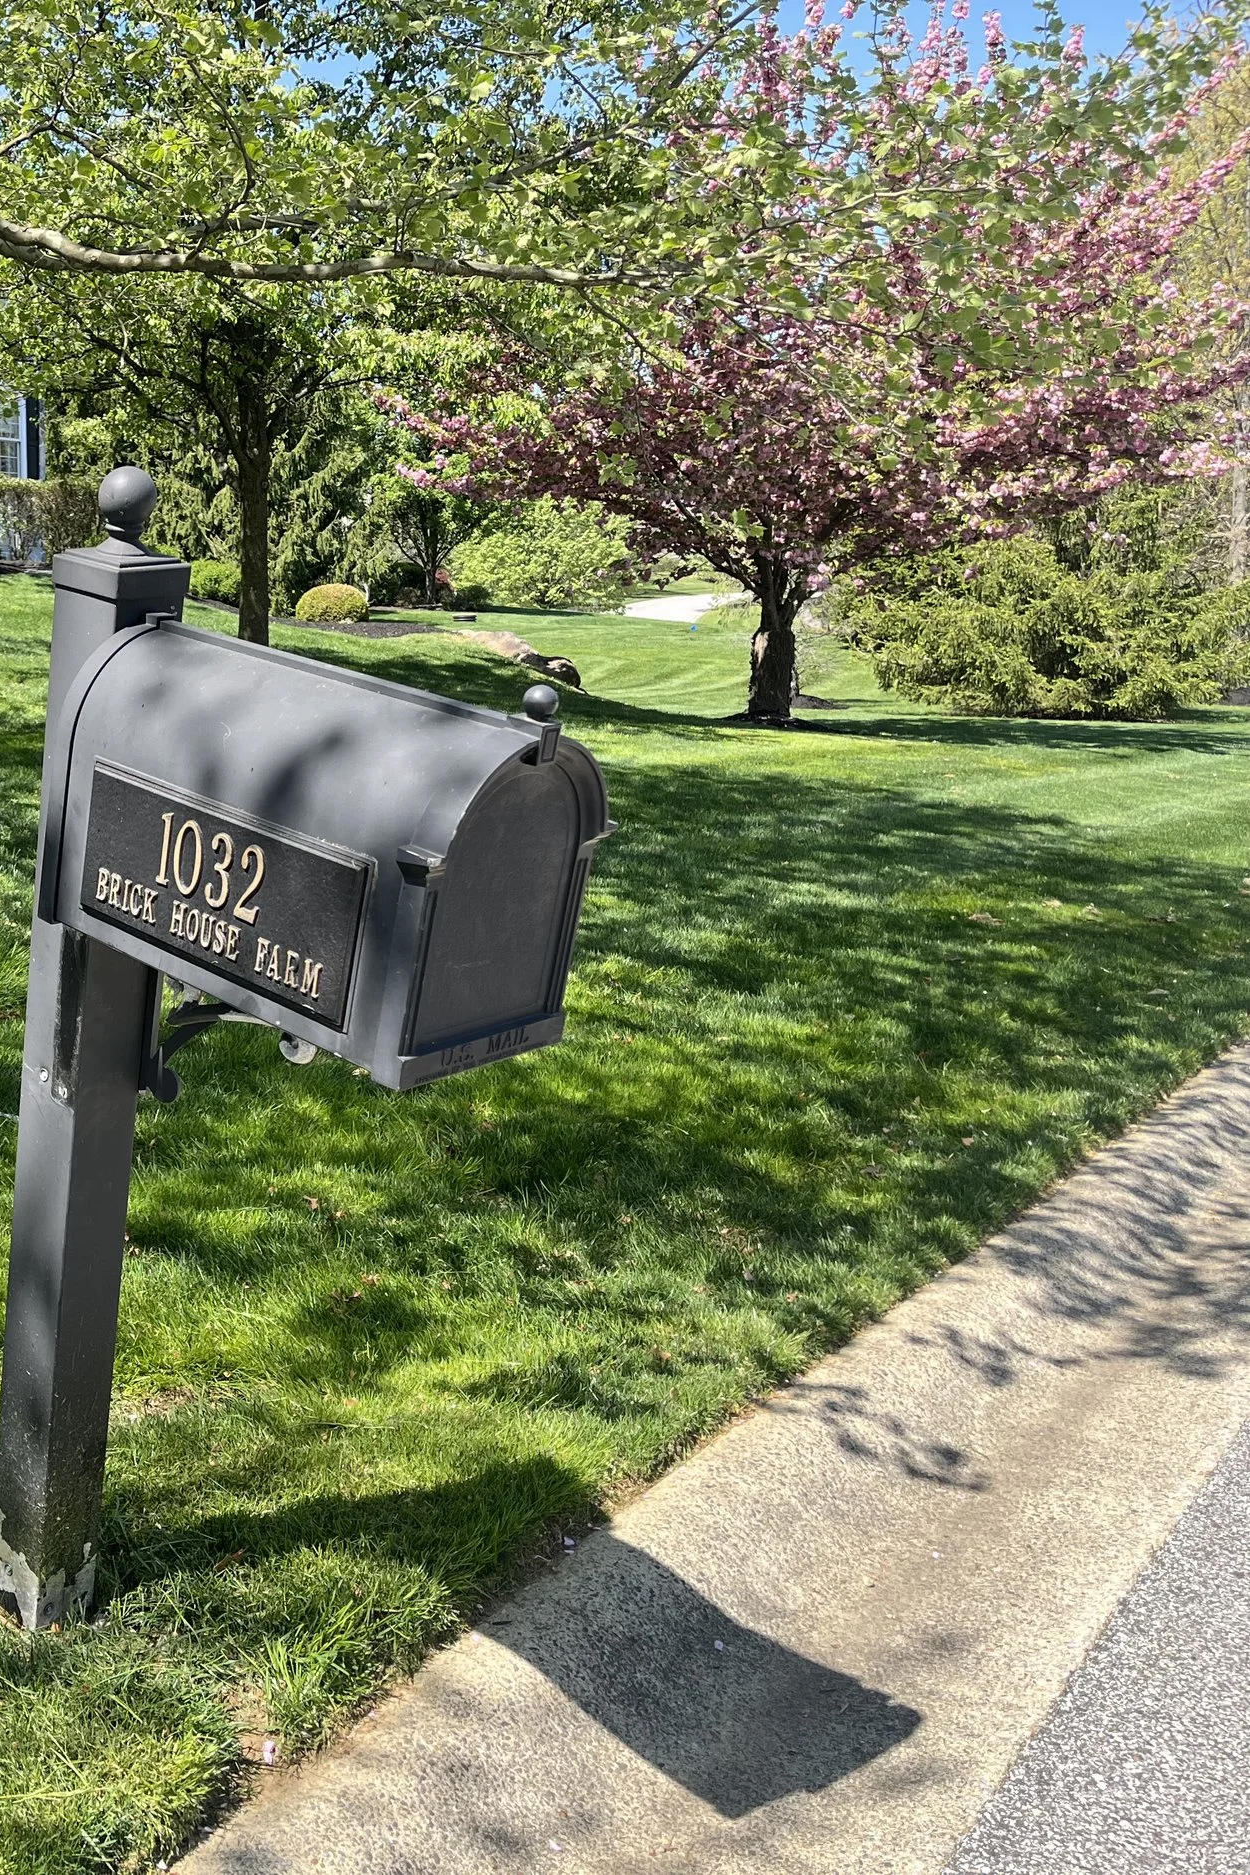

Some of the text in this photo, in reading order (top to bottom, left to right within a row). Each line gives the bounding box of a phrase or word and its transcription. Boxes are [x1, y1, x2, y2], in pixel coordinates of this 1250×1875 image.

[156, 812, 265, 924] 1032
[95, 867, 324, 1000] BRICK HOUSE FARM
[441, 1043, 474, 1067] U.S.
[486, 1027, 530, 1055] MAIL
